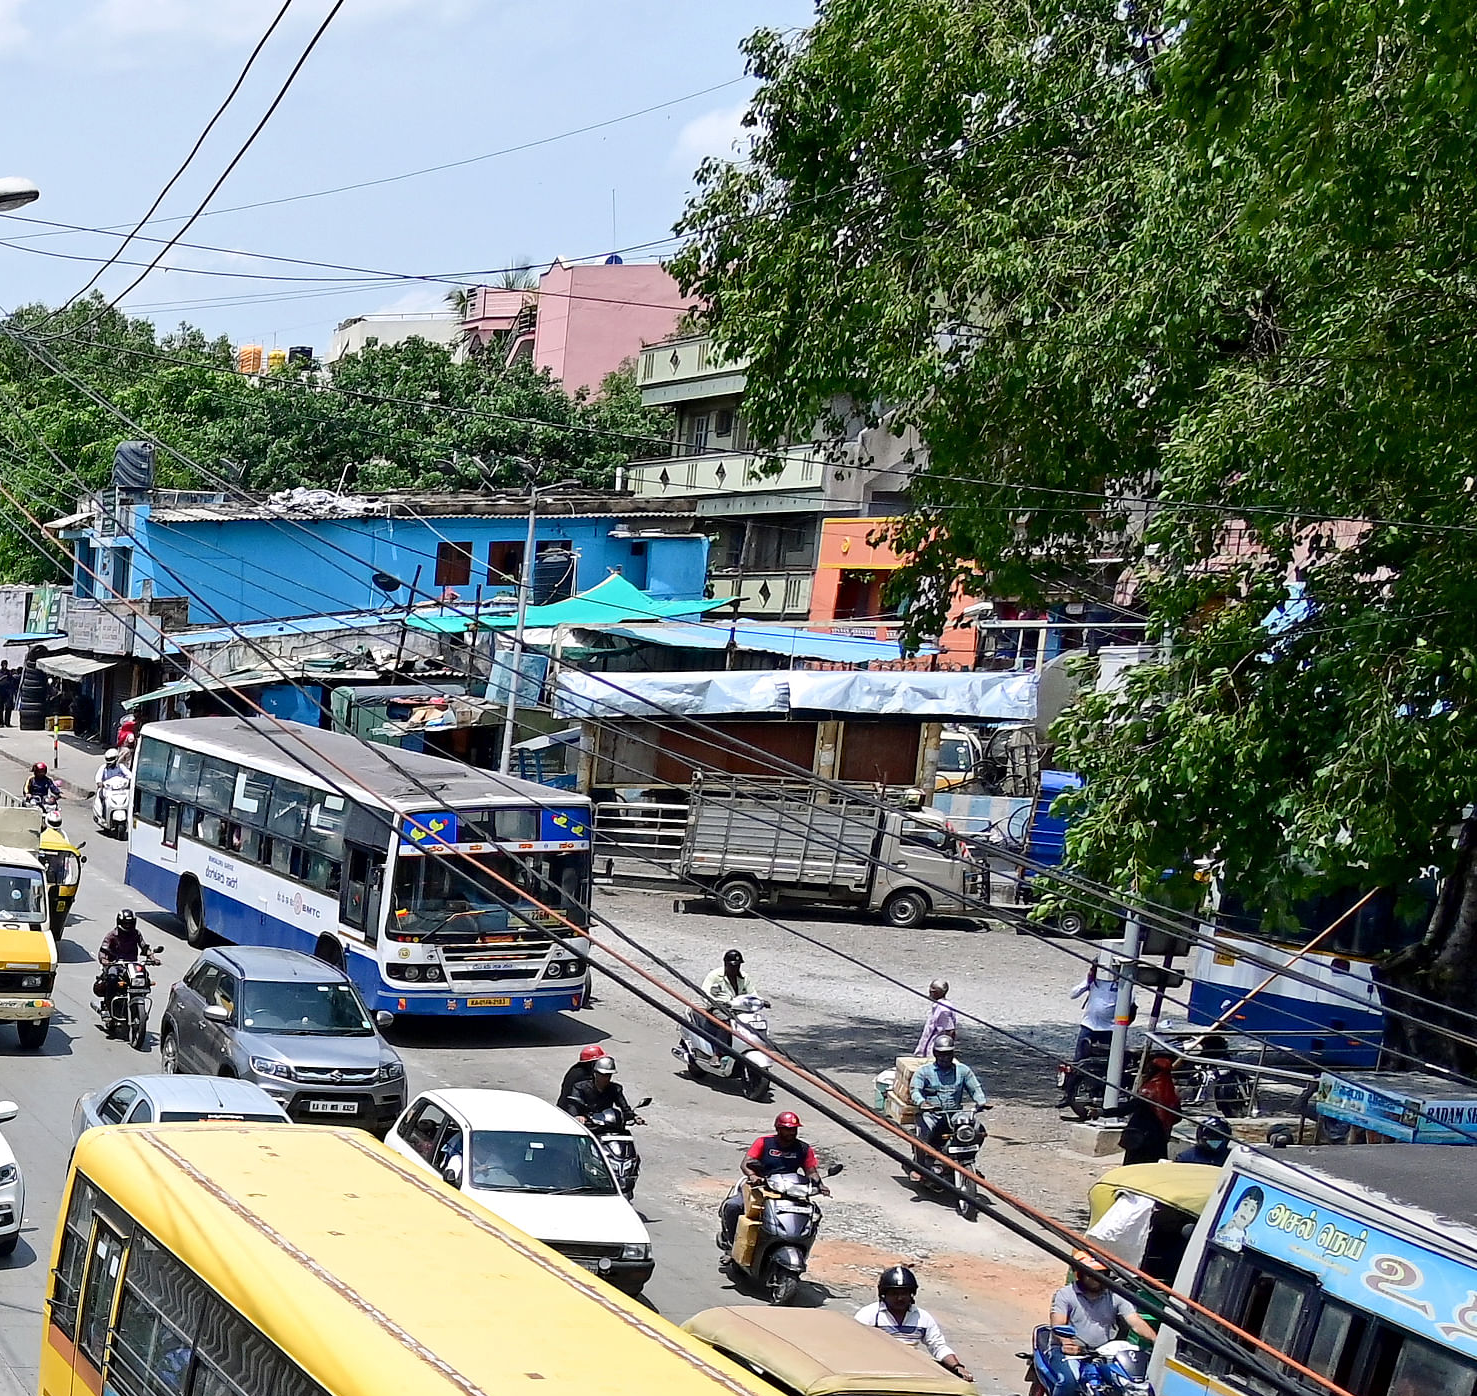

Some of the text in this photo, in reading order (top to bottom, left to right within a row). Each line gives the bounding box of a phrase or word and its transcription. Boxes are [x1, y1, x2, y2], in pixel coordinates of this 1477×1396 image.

[302, 903, 321, 919] BMTC
[1426, 1106, 1463, 1125] BADAM
[1266, 1203, 1318, 1242] அசல்
[1316, 1222, 1370, 1262] நெய்
